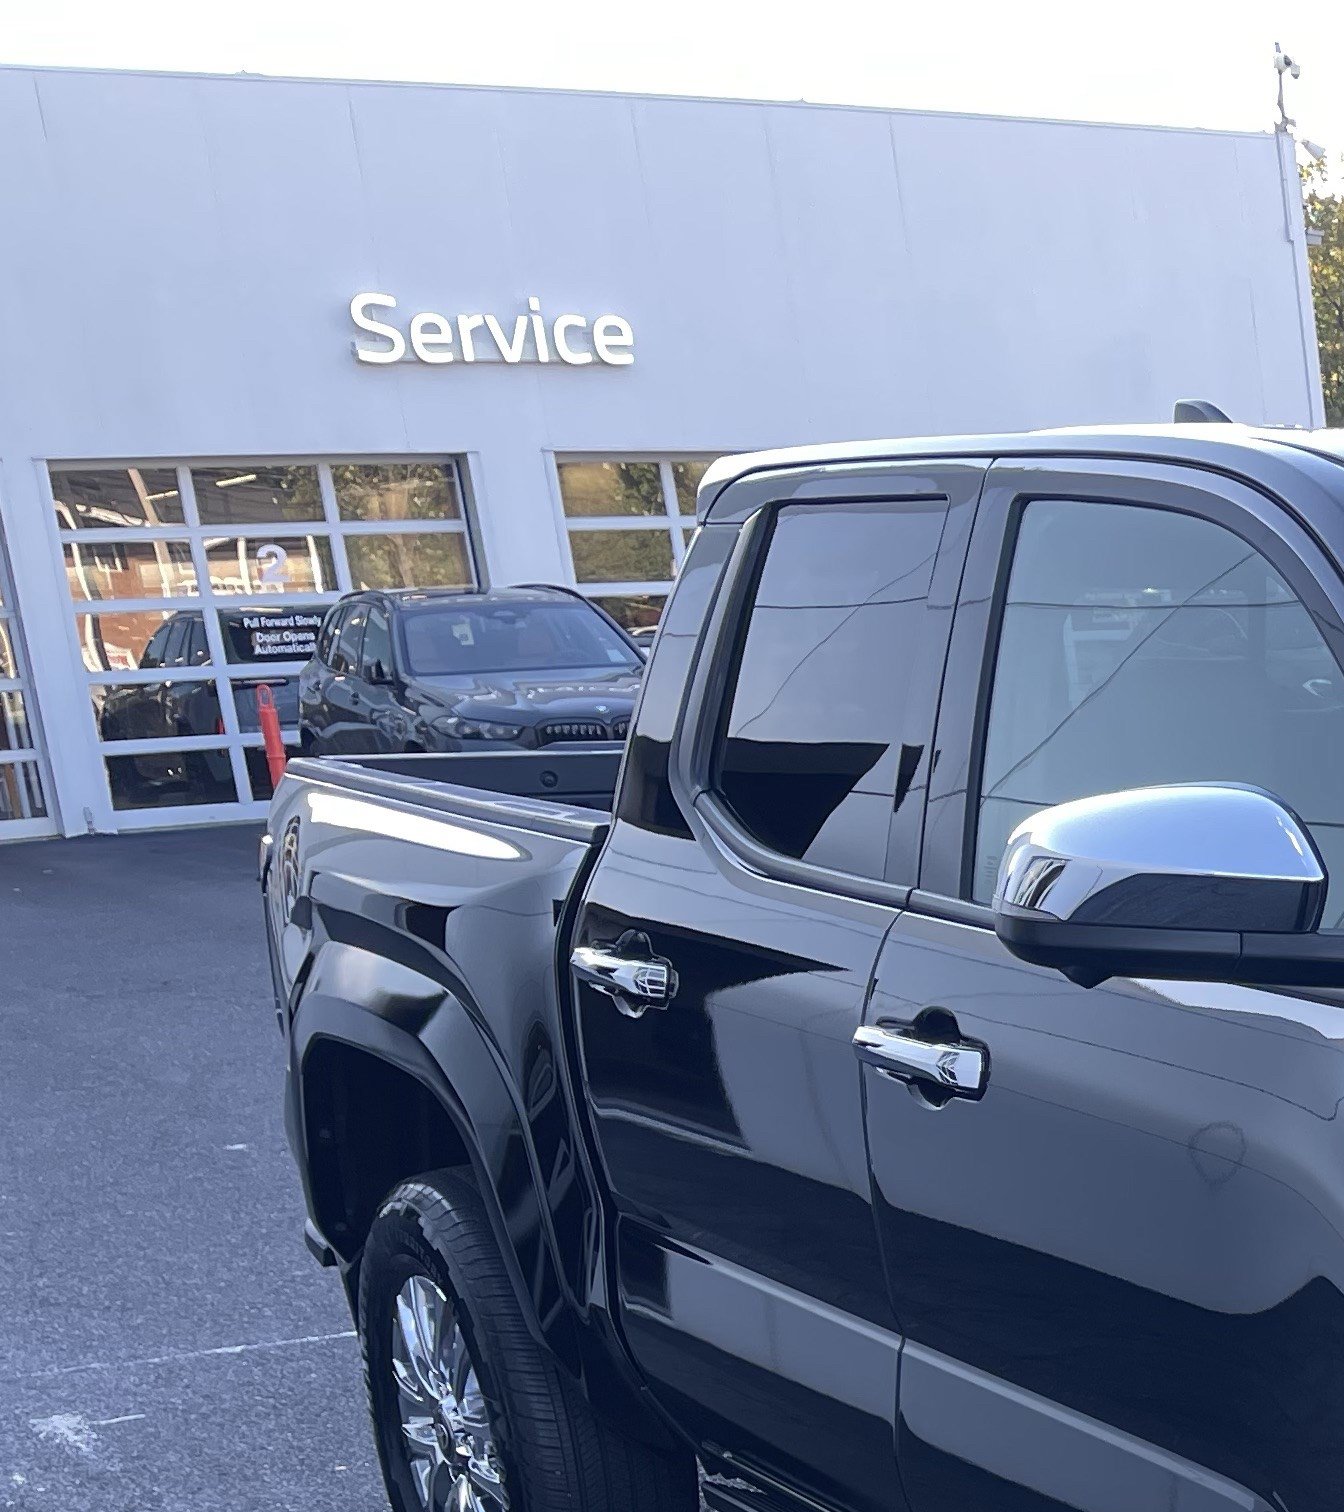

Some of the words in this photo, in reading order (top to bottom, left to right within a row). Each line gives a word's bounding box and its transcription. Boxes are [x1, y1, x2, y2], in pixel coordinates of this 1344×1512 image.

[349, 292, 635, 365] Service
[256, 544, 290, 583] 2
[243, 617, 259, 628] Pull
[260, 616, 295, 628] Forward
[295, 615, 321, 627] Slowly
[256, 632, 280, 643] Door
[282, 631, 316, 643] Opens
[254, 643, 317, 655] Automaticall
